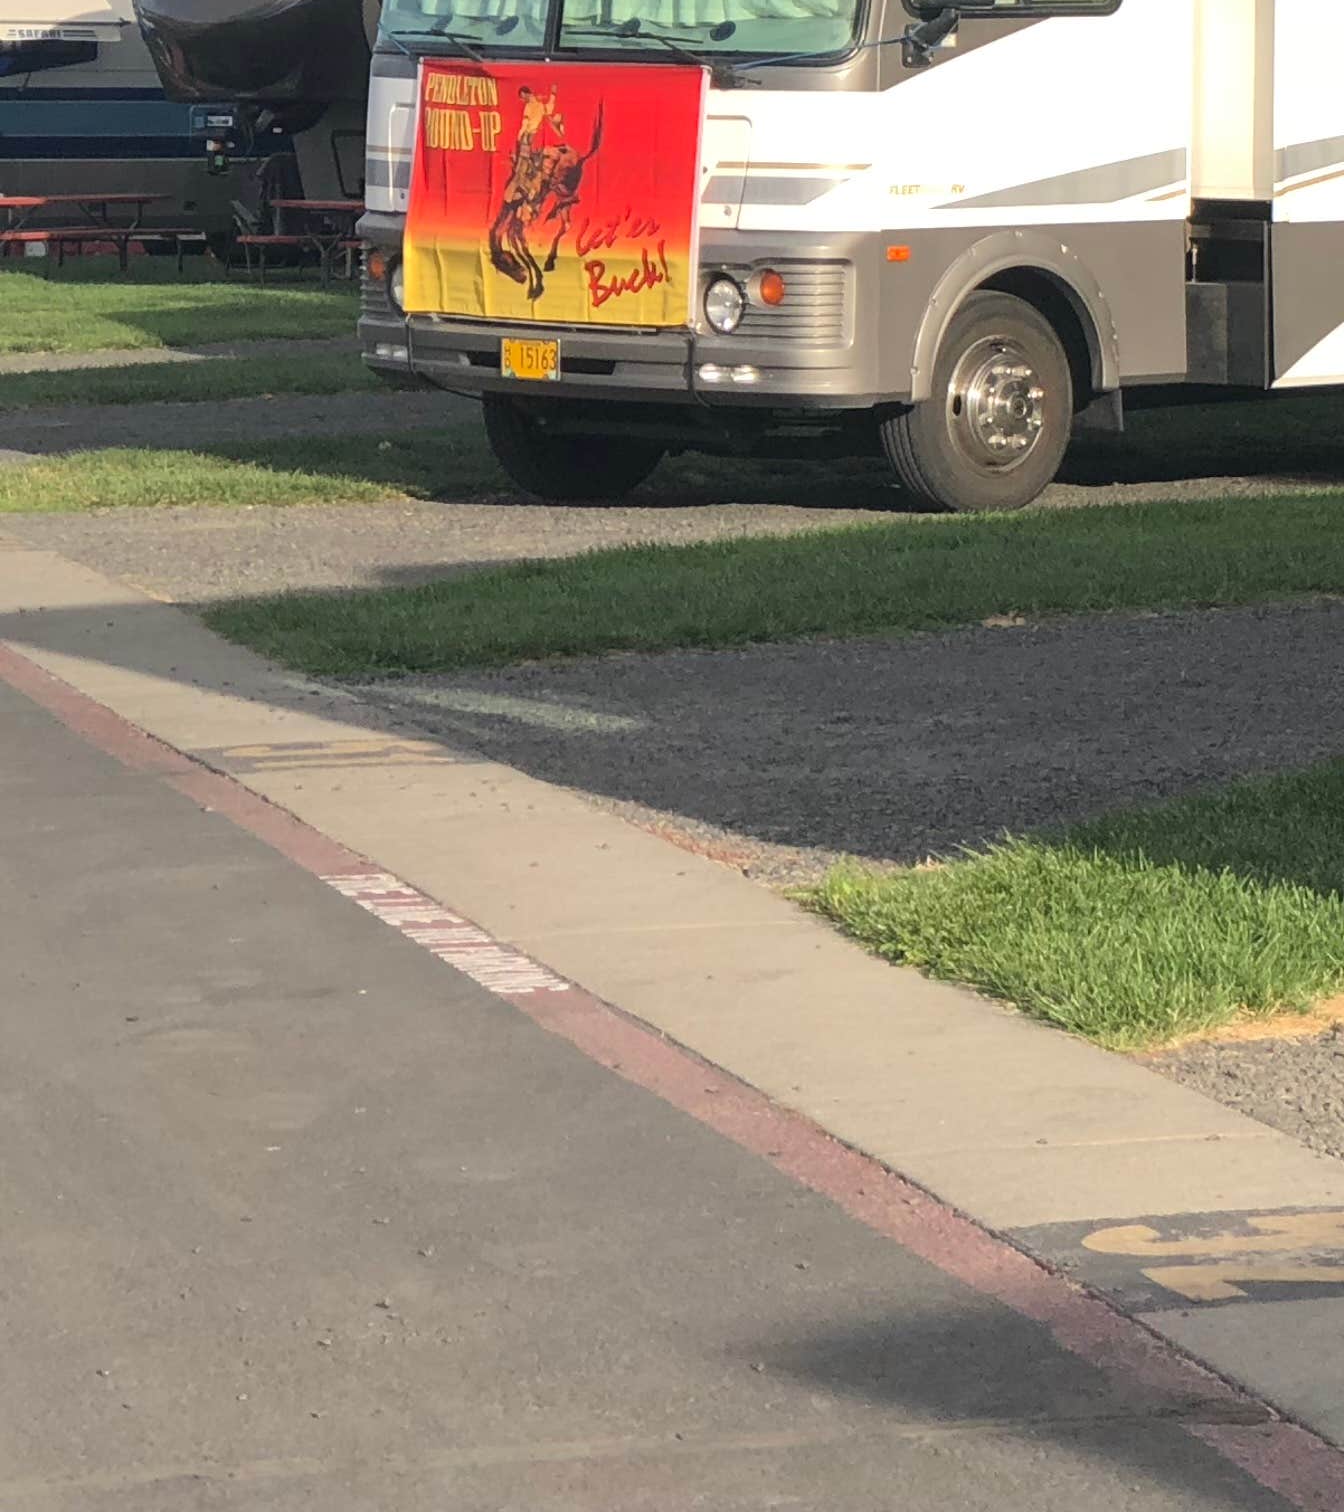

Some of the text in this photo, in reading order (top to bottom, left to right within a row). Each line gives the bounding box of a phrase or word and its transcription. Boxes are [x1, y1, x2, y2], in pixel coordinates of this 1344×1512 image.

[17, 29, 62, 39] SAFARI
[424, 72, 499, 107] PENDLETON
[425, 107, 502, 152] ROUND-UP
[576, 206, 661, 256] Let'er
[585, 239, 672, 308] Buck!
[520, 346, 557, 370] 15163
